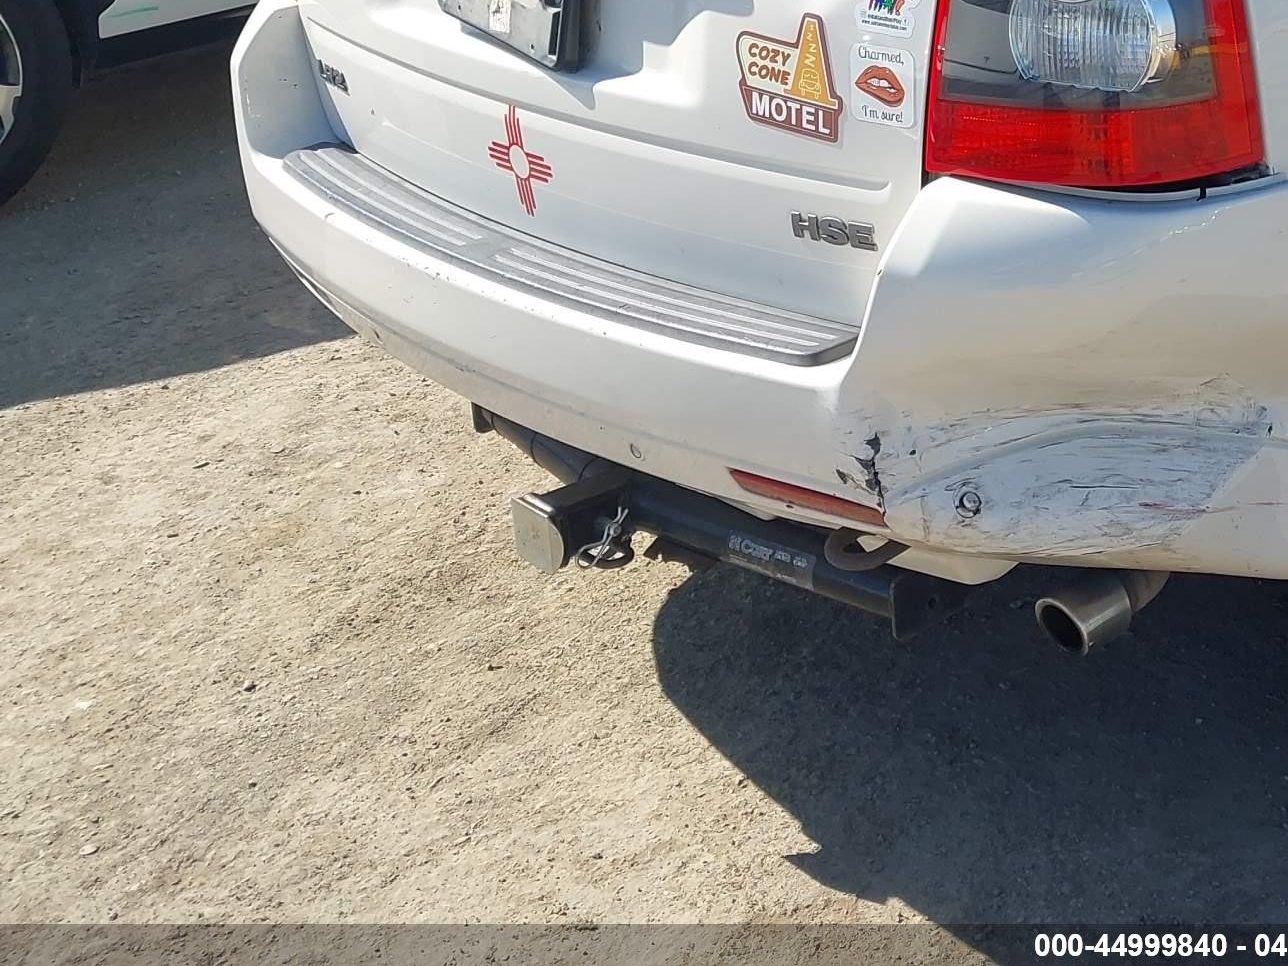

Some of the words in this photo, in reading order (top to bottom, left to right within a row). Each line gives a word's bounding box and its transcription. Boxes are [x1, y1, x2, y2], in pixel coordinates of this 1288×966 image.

[748, 43, 792, 67] COZY
[858, 45, 905, 66] Charmed,
[748, 62, 791, 86] CONE
[751, 92, 831, 135] MOTEL
[862, 105, 880, 119] I'm
[881, 111, 904, 123] sure!
[791, 211, 878, 251] HSE
